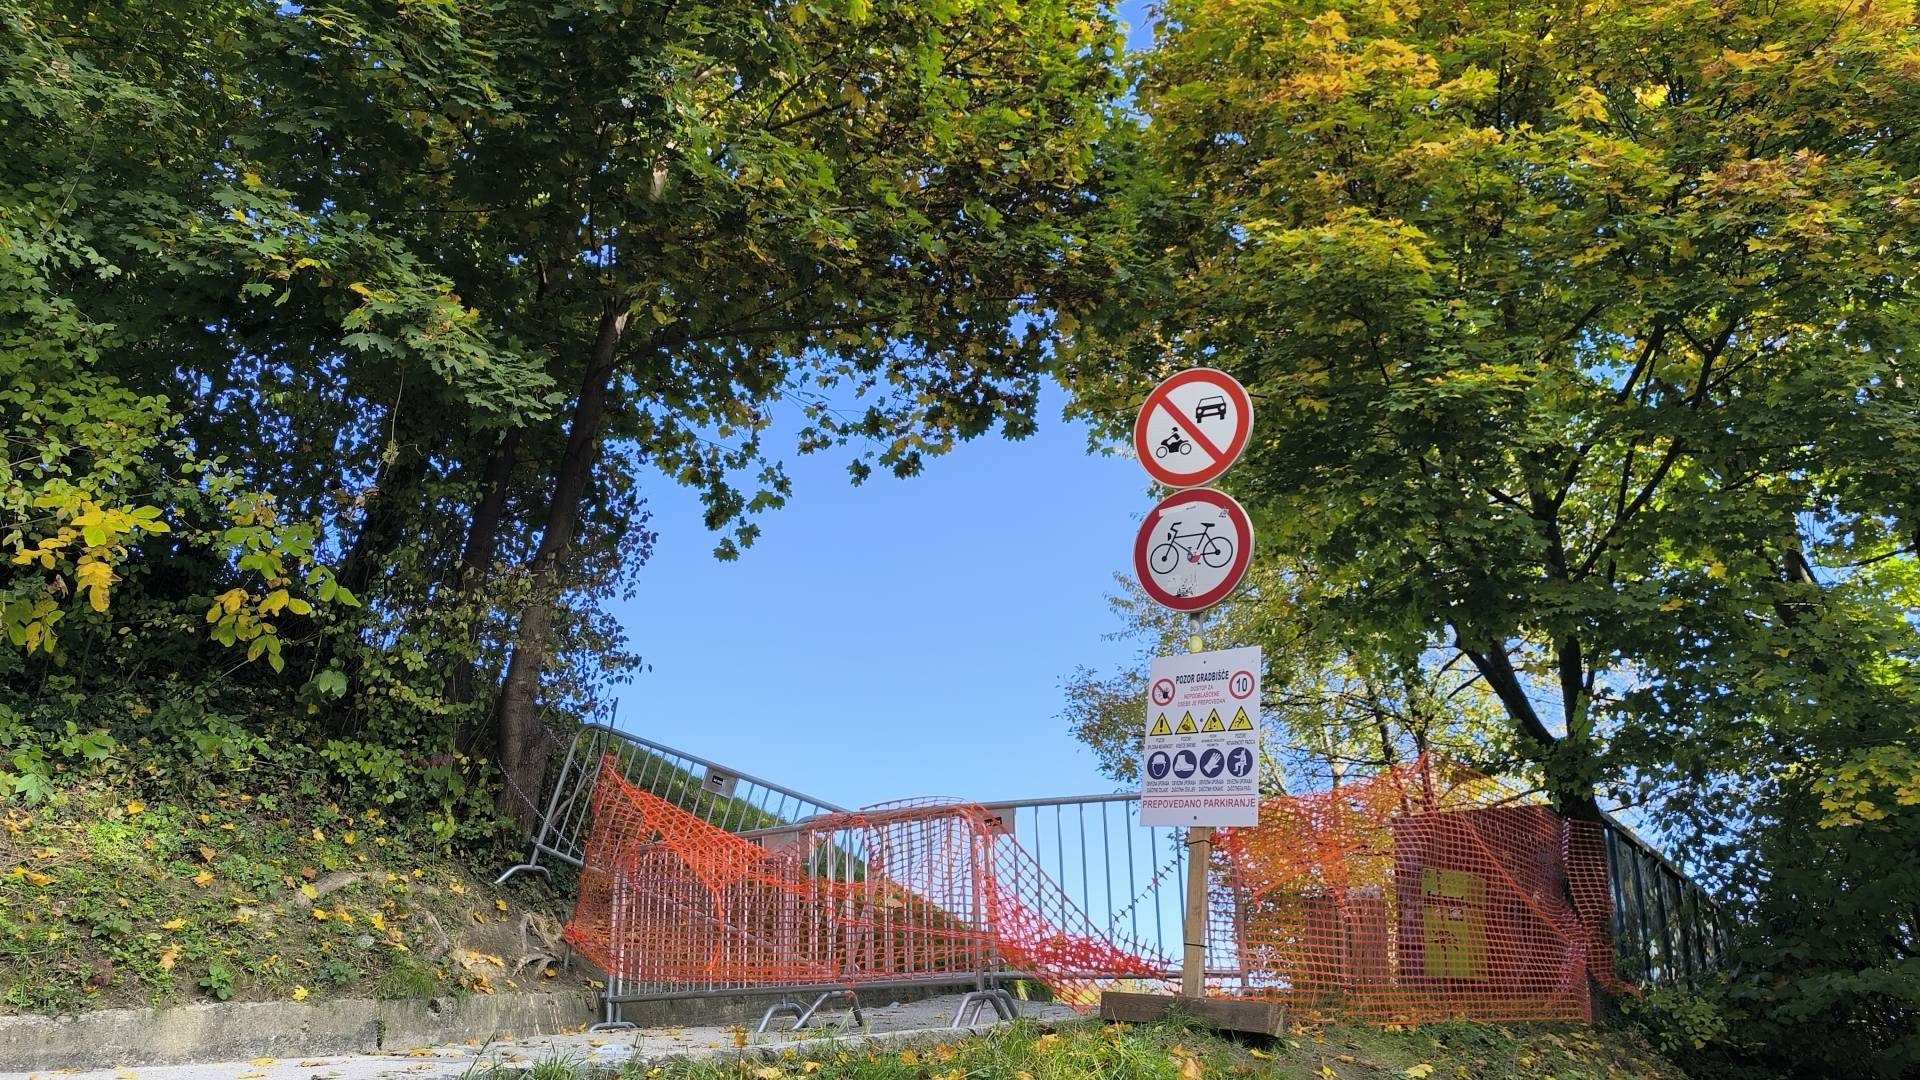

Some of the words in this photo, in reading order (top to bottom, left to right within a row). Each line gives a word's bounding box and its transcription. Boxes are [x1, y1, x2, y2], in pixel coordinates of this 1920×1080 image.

[1175, 674, 1195, 685] POZOR
[1196, 669, 1229, 683] GRADBIŠČE
[1236, 678, 1248, 692] 10
[1142, 799, 1201, 809] PREPOVEDANO
[1203, 798, 1256, 808] PARKIRANJE
